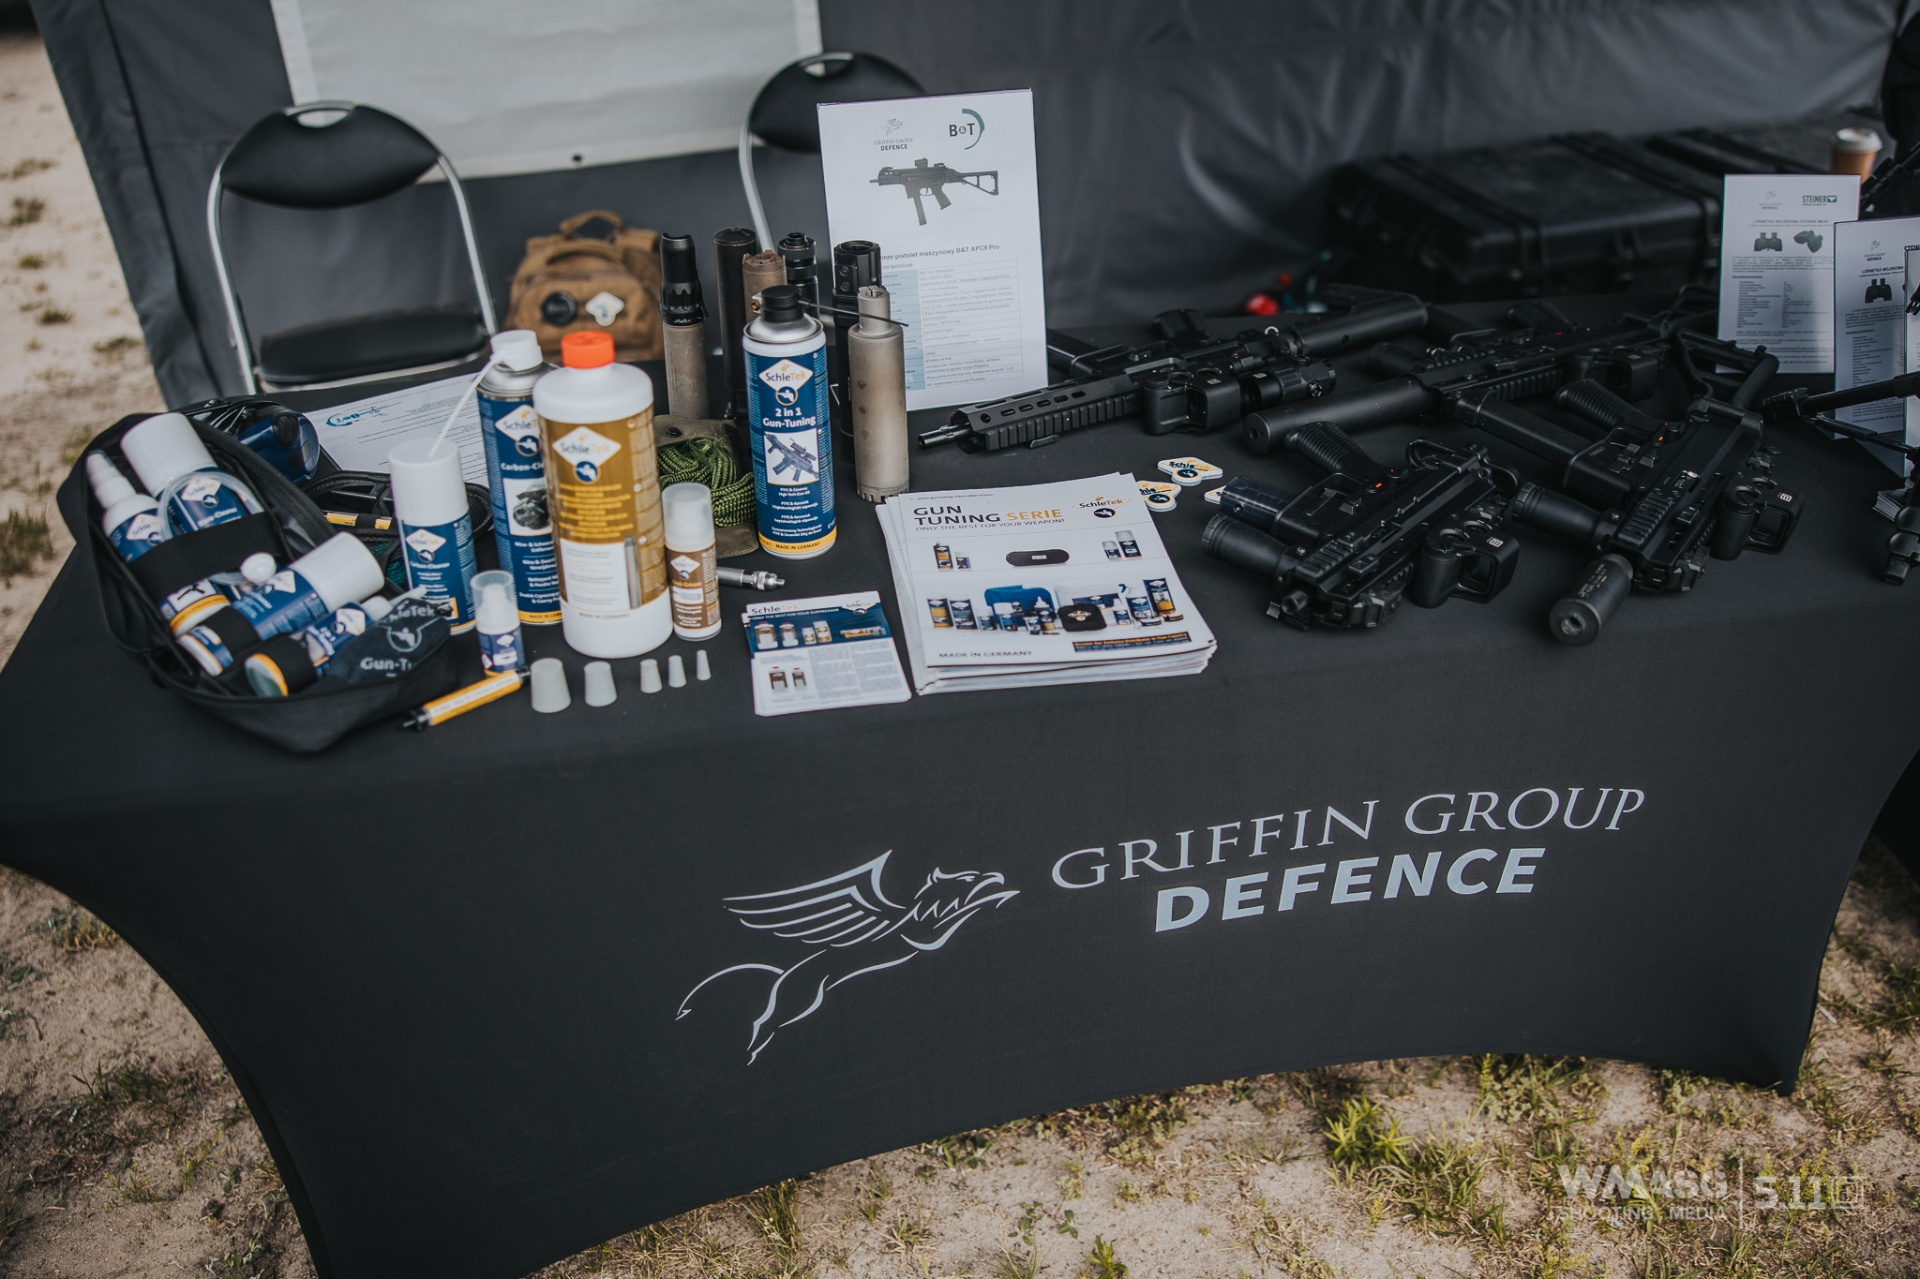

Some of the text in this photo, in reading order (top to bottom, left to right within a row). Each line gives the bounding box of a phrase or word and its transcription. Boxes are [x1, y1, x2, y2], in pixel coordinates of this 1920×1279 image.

[1802, 195, 1827, 203] STEINER
[894, 251, 918, 260] pistolet
[919, 248, 955, 257] maszynowy
[970, 244, 988, 252] APC9
[765, 371, 806, 381] SchleTek
[775, 407, 802, 417] 2 in 1
[502, 419, 537, 430] SchleT
[762, 416, 816, 428] Gun-Tuning
[560, 442, 611, 454] SchleTek
[1168, 461, 1211, 471] SchleTek
[1079, 499, 1124, 509] SchleTek
[913, 505, 962, 516] GUN
[914, 508, 1063, 526] TUNING SERIE
[1024, 518, 1065, 526] WEAPON!
[797, 541, 820, 550] GERMANY
[751, 604, 799, 614] SchleTek
[1050, 787, 1646, 890] GRIFFIN GROUP
[1154, 846, 1546, 933] DEFENCE
